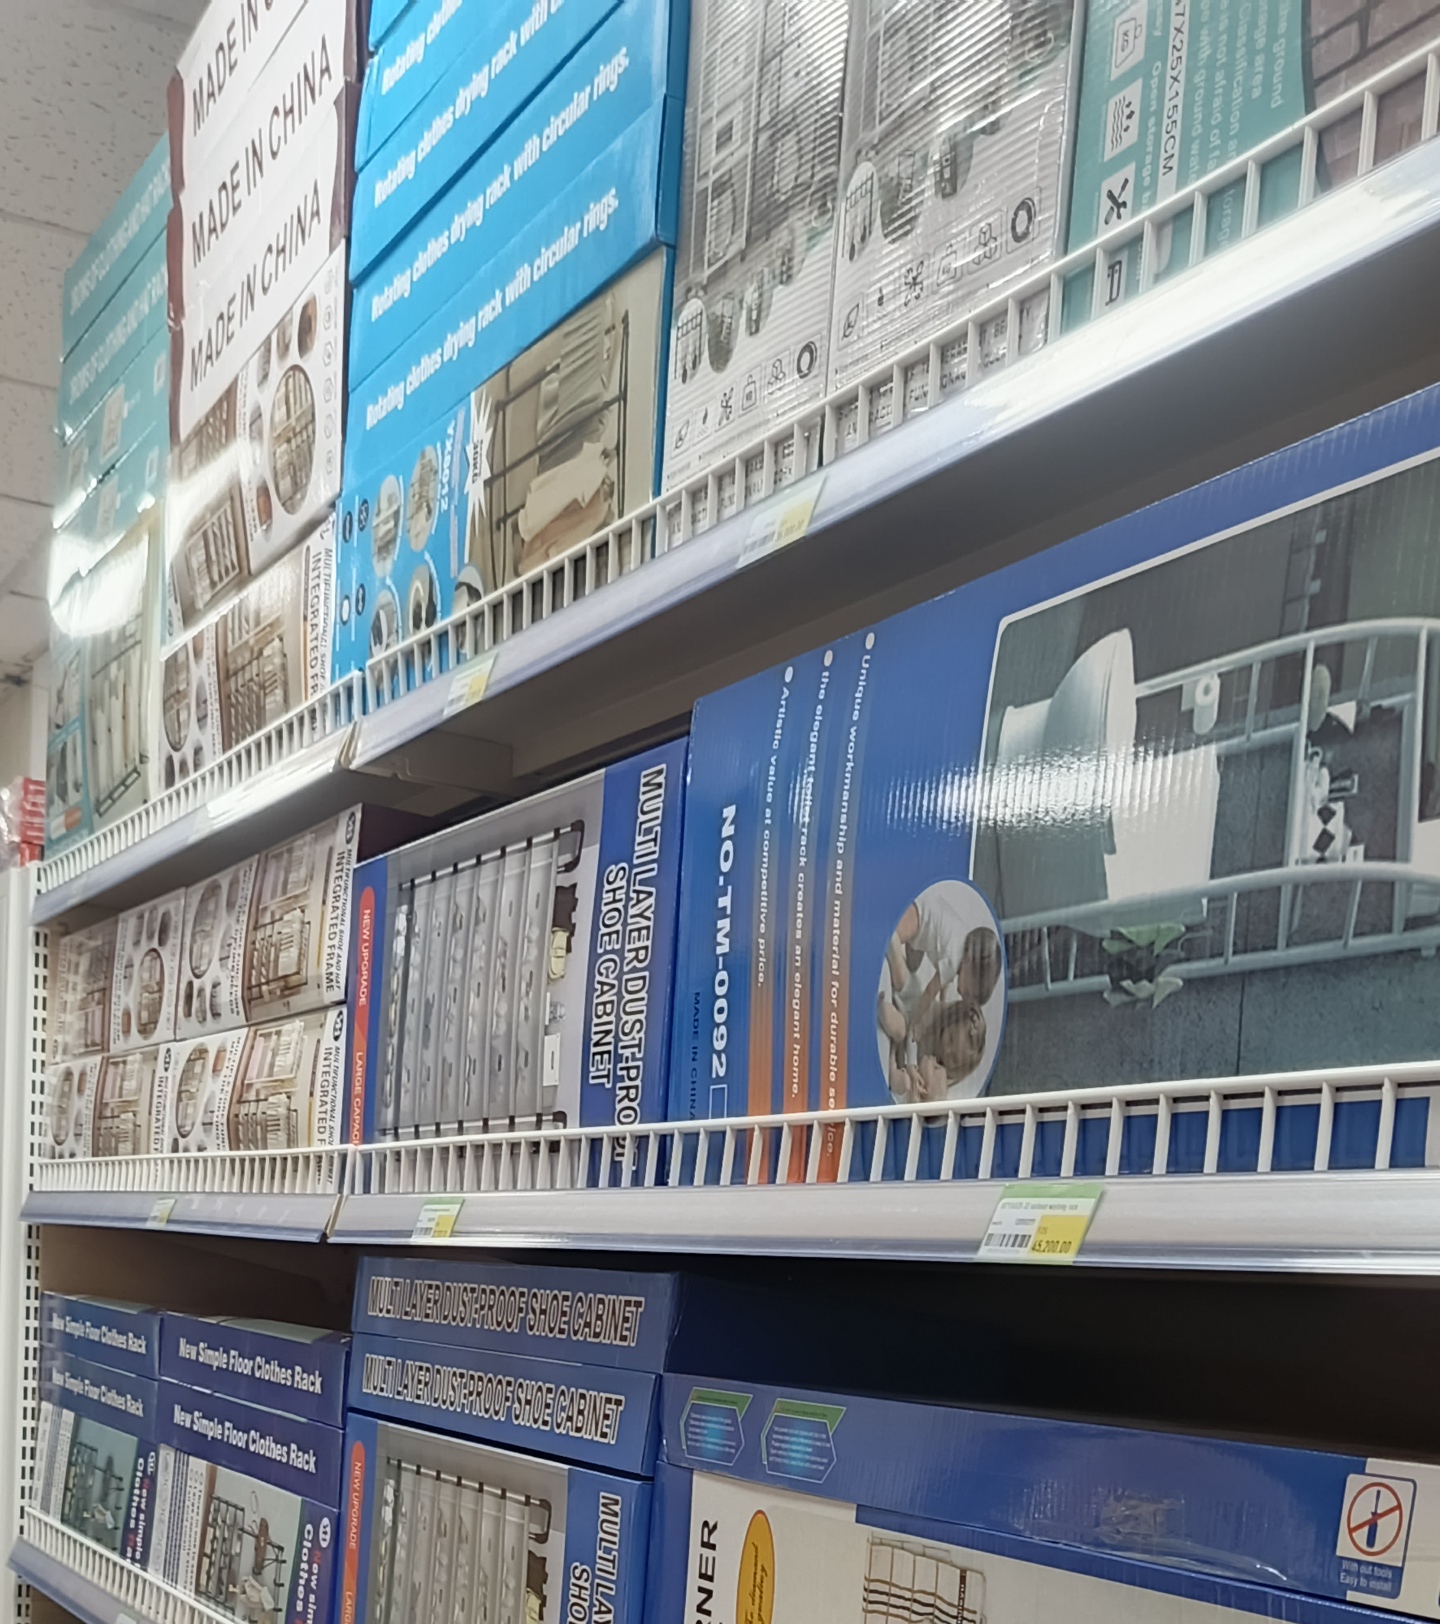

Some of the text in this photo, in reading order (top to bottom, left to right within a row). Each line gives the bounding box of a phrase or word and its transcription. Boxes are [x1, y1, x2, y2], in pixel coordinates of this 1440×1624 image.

[192, 0, 258, 137] MADE IN
[374, 0, 549, 209] Rotating clothes drying rack with
[381, 31, 426, 96] Rotating
[1149, 60, 1162, 111] Open
[1191, 70, 1206, 138] ground
[1270, 38, 1287, 109] ground
[191, 33, 333, 268] MADE IN CHINA
[371, 46, 630, 322] Rotating clothes drying rack with circular rings.
[190, 178, 321, 392] MADE IN CHINA
[365, 186, 620, 431] Rotating clothes drying rack with circular rings.
[310, 551, 322, 669] INTEGRATED
[631, 764, 667, 865] MULTI
[757, 686, 791, 987] Artistic value at competitive price.
[791, 671, 830, 1098] the elegant rack creates an elegant home.
[828, 655, 871, 1081] Unique workmanship and material for durable
[325, 851, 346, 993] INTEGRATED FRAME
[624, 865, 658, 969] LAYER
[711, 804, 737, 1079] NO.TM-0092
[354, 909, 371, 1094] NEW UPGRADE LARGE
[588, 862, 630, 1088] SHOE CABINET
[317, 1047, 333, 1135] INTEGRATED
[689, 991, 701, 1121] MADE IN CHINA
[101, 1326, 127, 1349] Clothes
[127, 1332, 146, 1354] Rack
[368, 1276, 645, 1347] MULTI LAYER DUST-PROOF SHOE CABINET
[100, 1385, 125, 1410] Clothes
[126, 1394, 143, 1417] Rack
[179, 1337, 322, 1394] New Simple Floor Clothes Rack
[362, 1354, 625, 1445] MULTI LAYER DUST-PROOF SHOE CABINET
[173, 1404, 316, 1473] New Simple Floor Clothes Rack
[352, 1461, 362, 1490] NEW
[296, 1523, 314, 1612] Clothes
[349, 1493, 360, 1550] UPGRADE
[594, 1492, 622, 1581] MULTI
[311, 1551, 321, 1590] New
[1340, 1572, 1358, 1587] Easy
[1360, 1577, 1367, 1587] to
